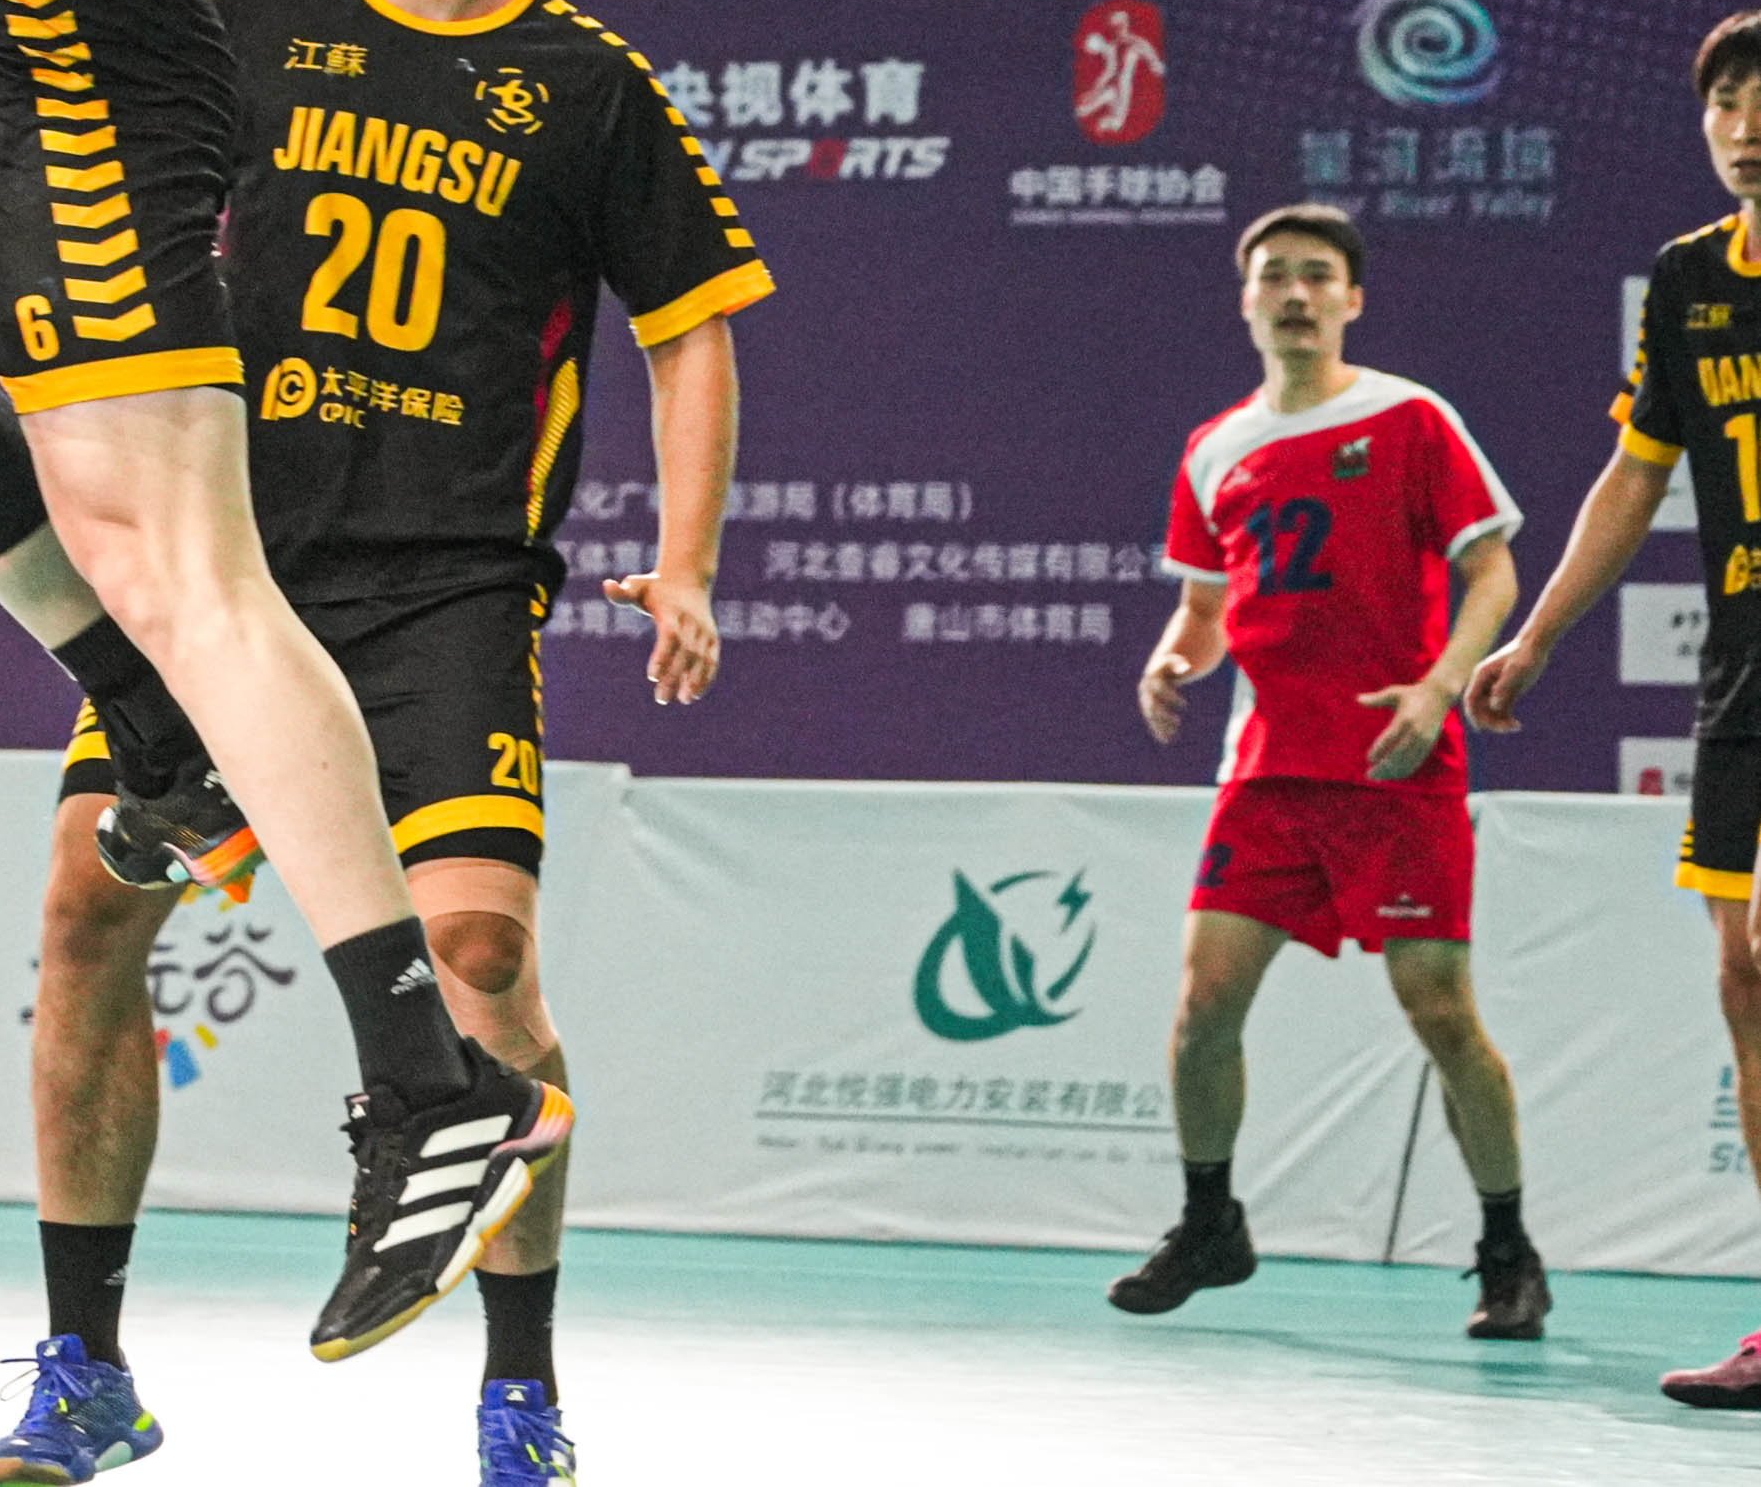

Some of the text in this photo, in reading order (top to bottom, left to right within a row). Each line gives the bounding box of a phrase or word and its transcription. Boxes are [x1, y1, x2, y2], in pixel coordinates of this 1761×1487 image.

[273, 106, 522, 217] JIANGSU
[1010, 164, 1227, 203] 中国手球协会
[301, 192, 446, 352] 20
[14, 294, 61, 361] 6
[1248, 496, 1335, 597] 12
[488, 731, 540, 796] 20
